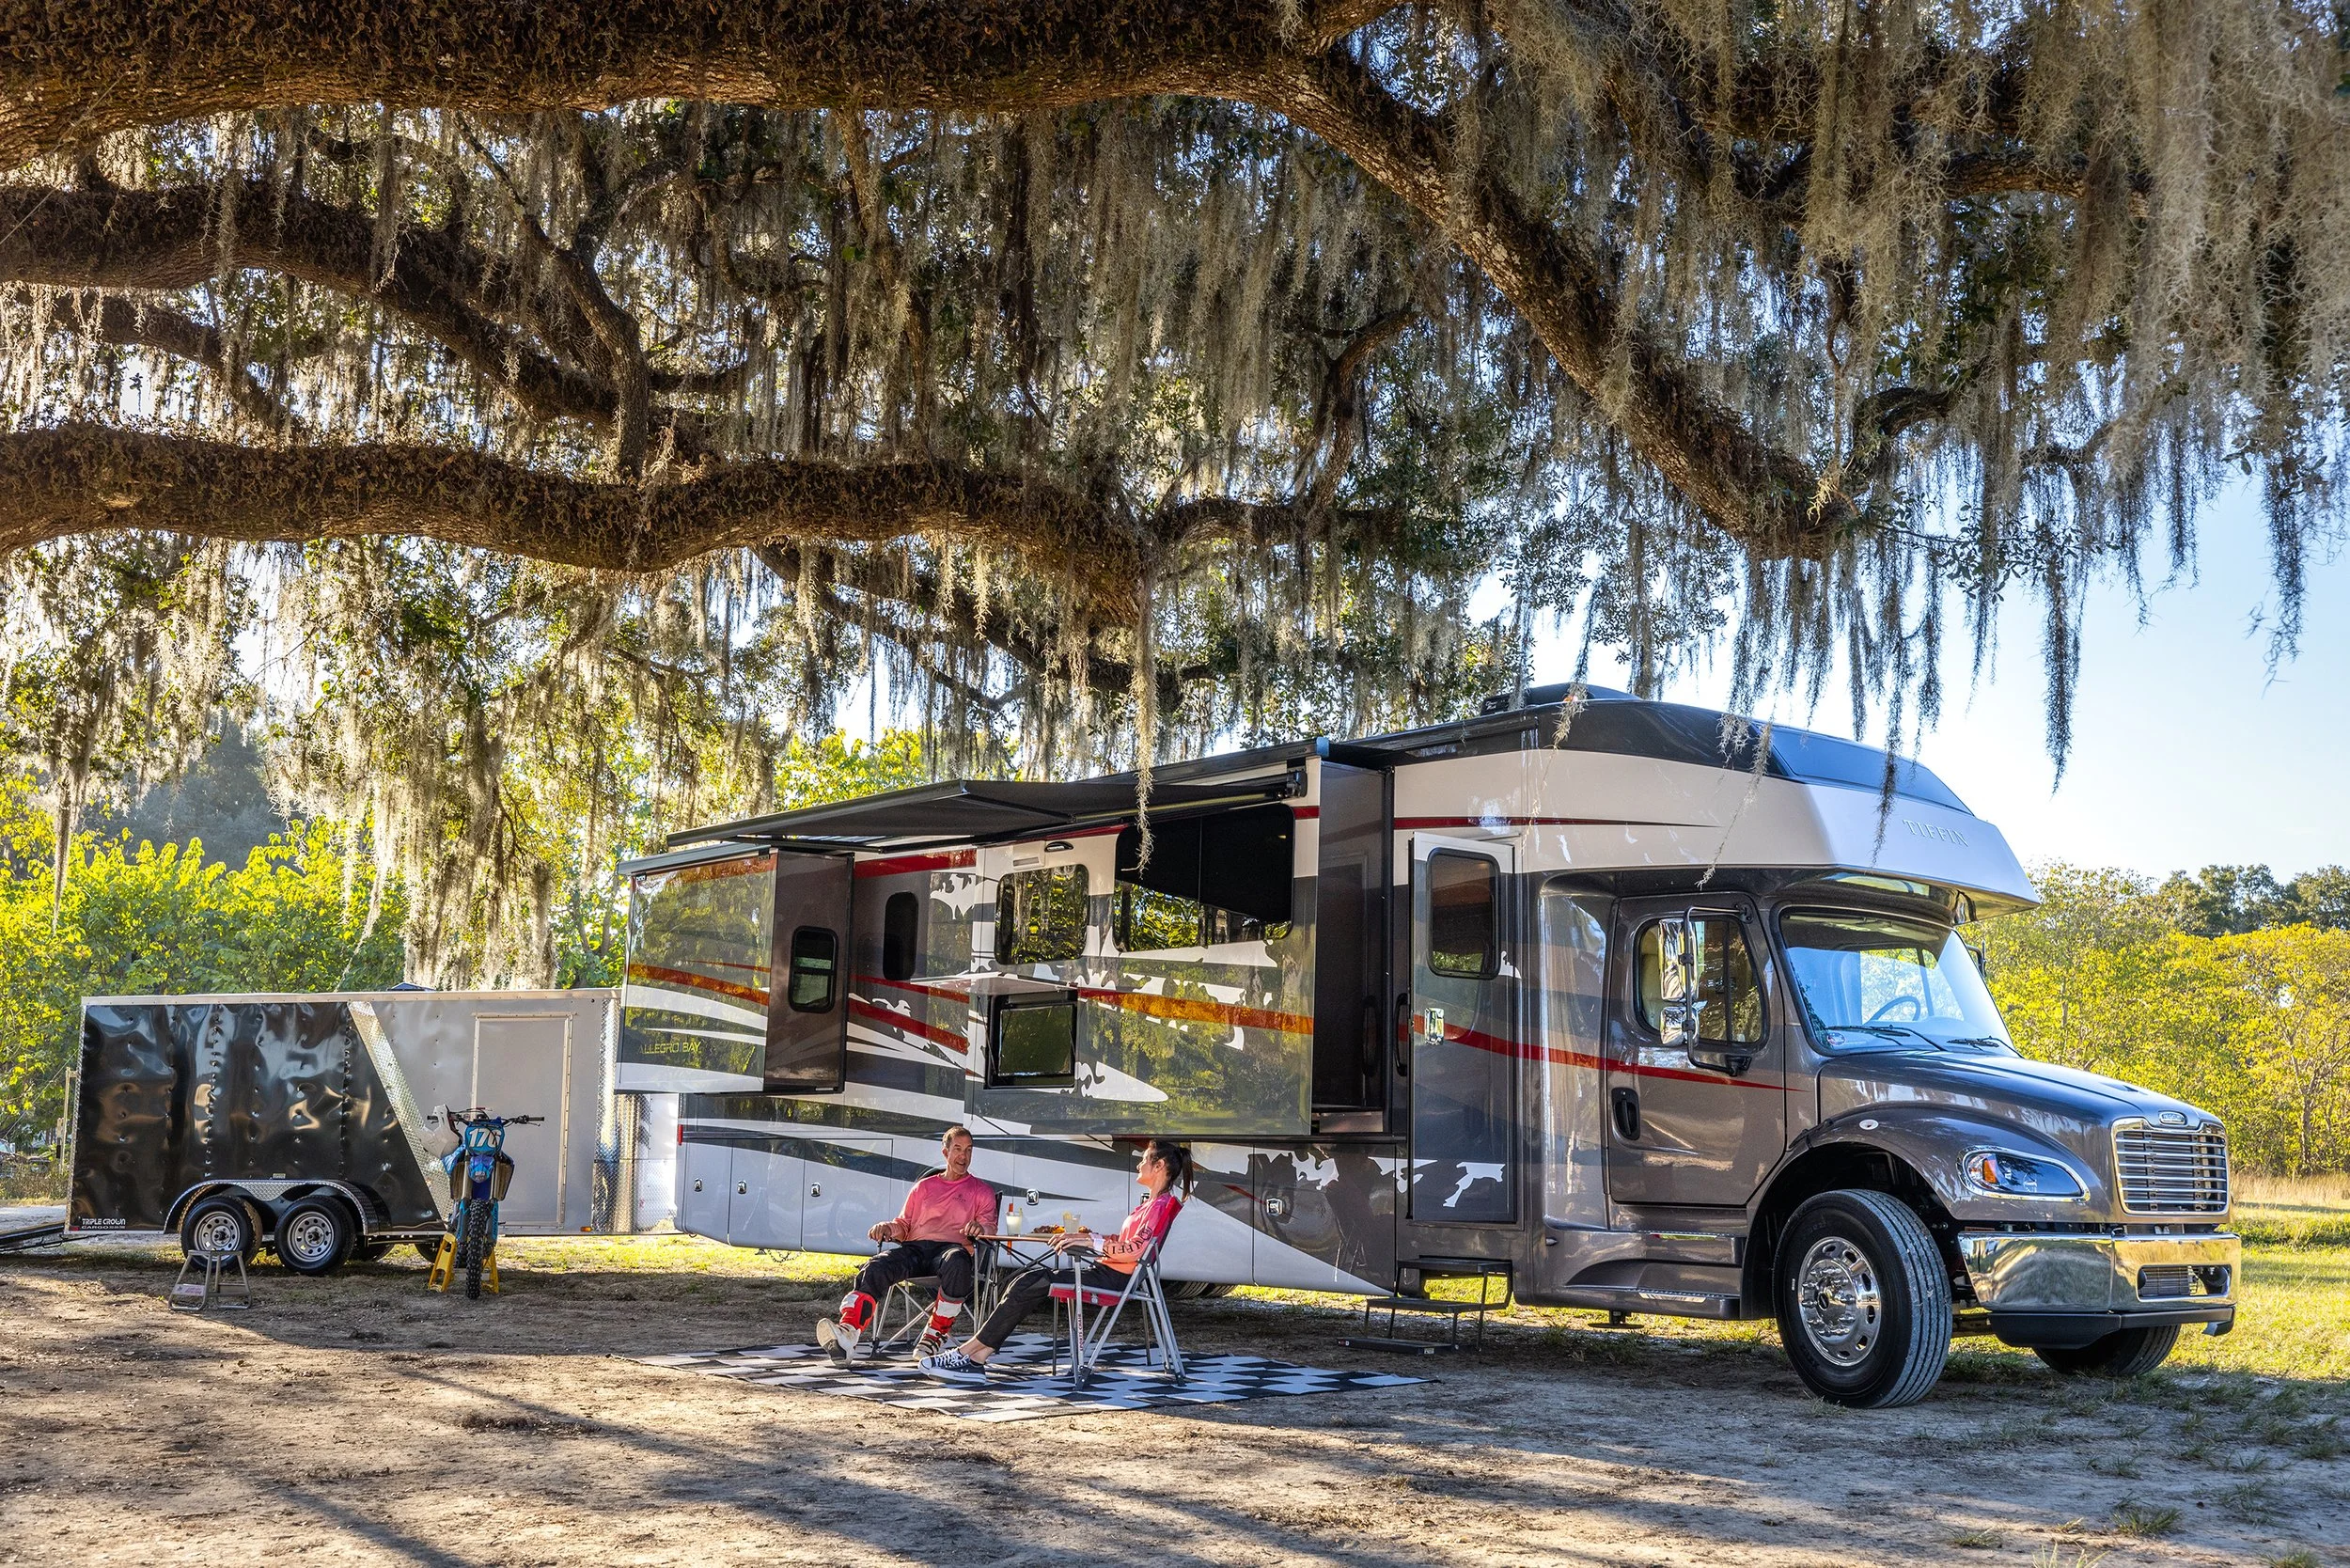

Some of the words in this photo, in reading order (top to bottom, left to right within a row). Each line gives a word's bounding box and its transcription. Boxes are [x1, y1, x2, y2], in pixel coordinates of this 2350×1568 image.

[1902, 819, 1969, 847] TIFFIN
[639, 1043, 680, 1054] ALLEGRO
[682, 1041, 702, 1053] BAY
[469, 1128, 502, 1148] 176
